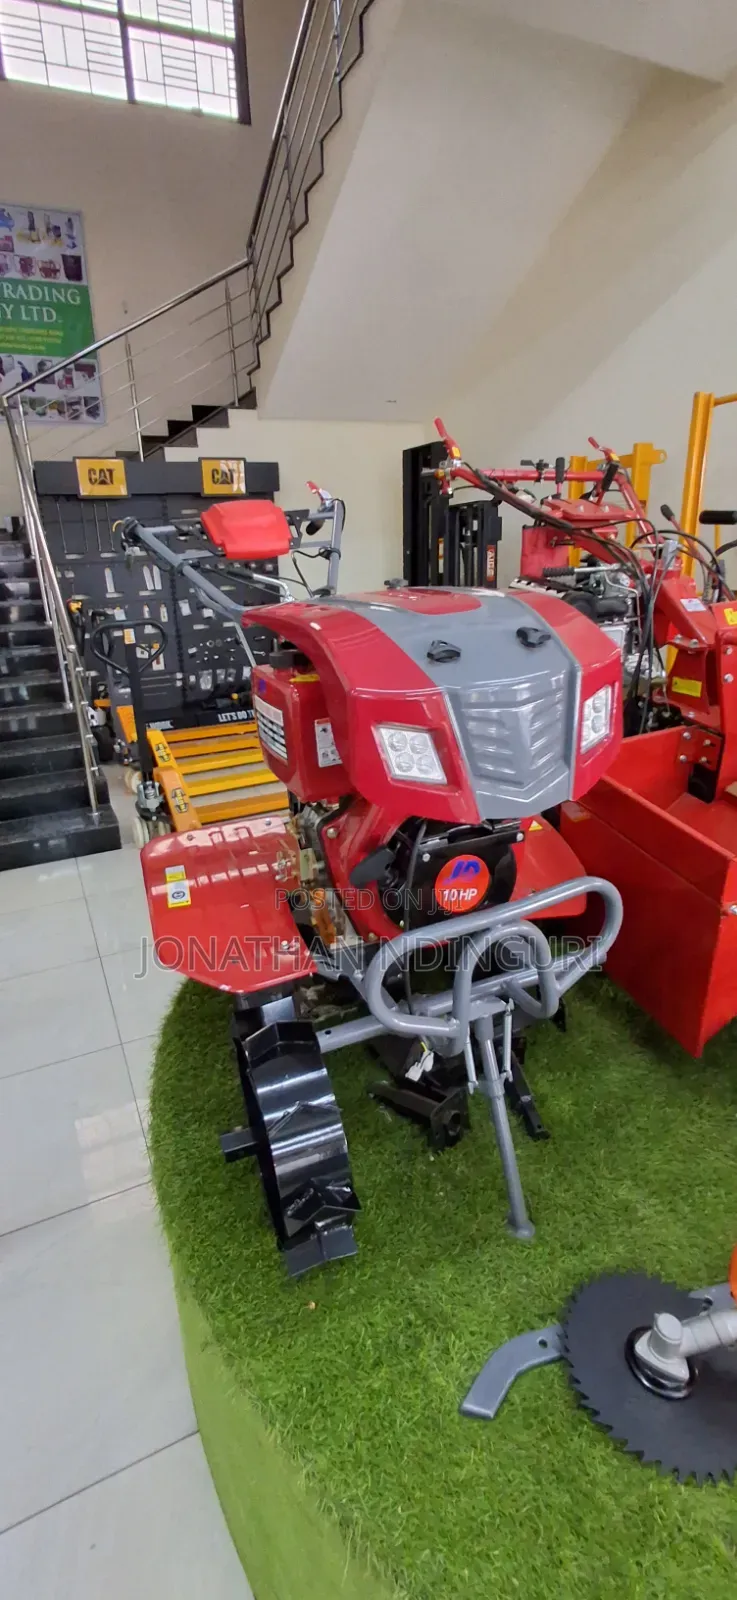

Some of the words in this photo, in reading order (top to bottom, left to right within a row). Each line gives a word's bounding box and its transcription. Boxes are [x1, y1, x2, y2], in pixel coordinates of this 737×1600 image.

[0, 282, 81, 305] RADING
[0, 302, 14, 320] Y
[88, 468, 114, 485] CAT
[211, 468, 236, 485] CAT
[217, 711, 237, 722] LET'S
[443, 888, 459, 902] 10
[459, 887, 478, 901] HP
